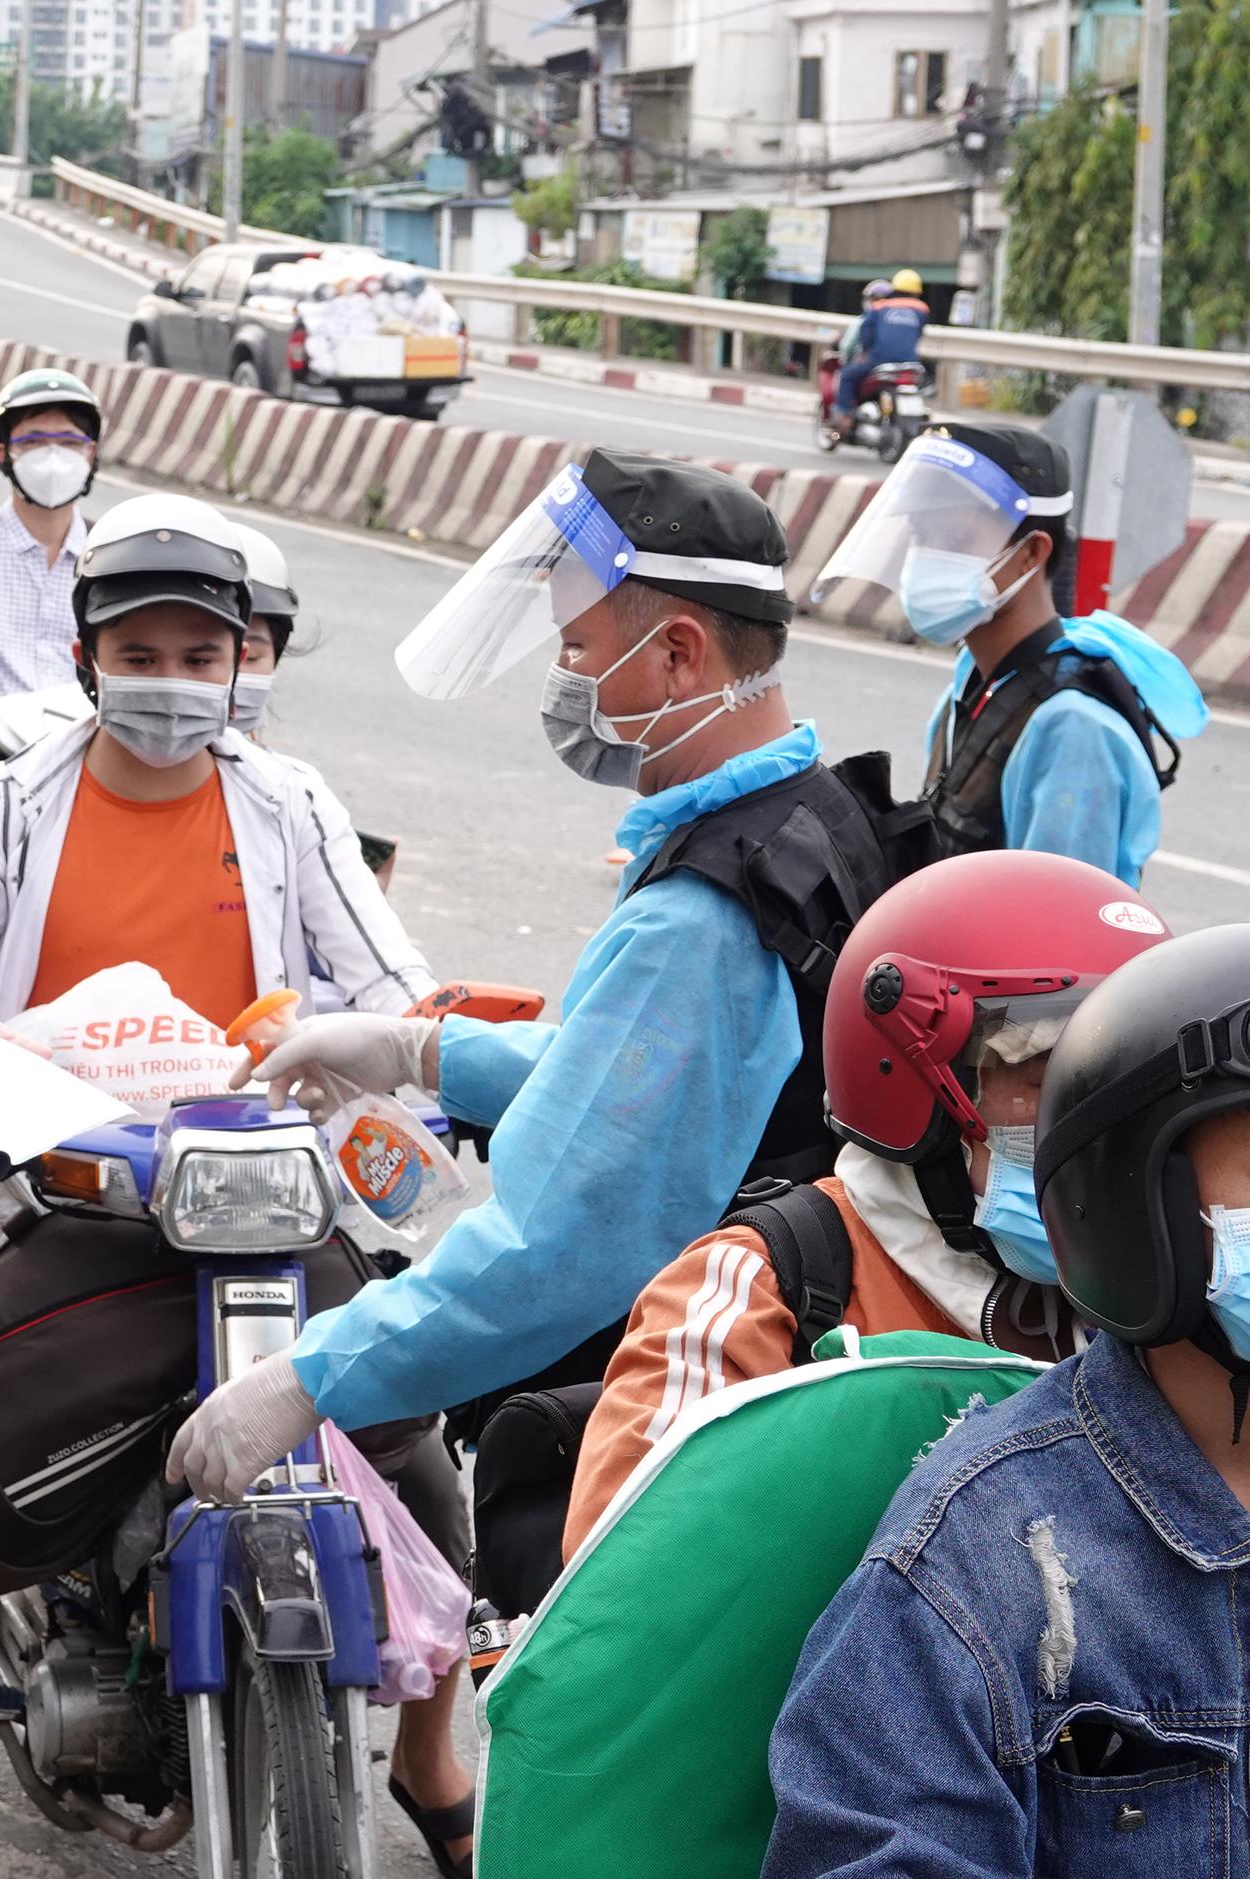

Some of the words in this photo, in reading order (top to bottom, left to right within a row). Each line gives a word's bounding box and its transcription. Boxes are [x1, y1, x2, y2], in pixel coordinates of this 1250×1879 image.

[140, 1058, 202, 1075] TRONG
[368, 1147, 404, 1197] Muscle
[232, 1290, 287, 1300] HONDA
[71, 1421, 125, 1454] COLLECTION
